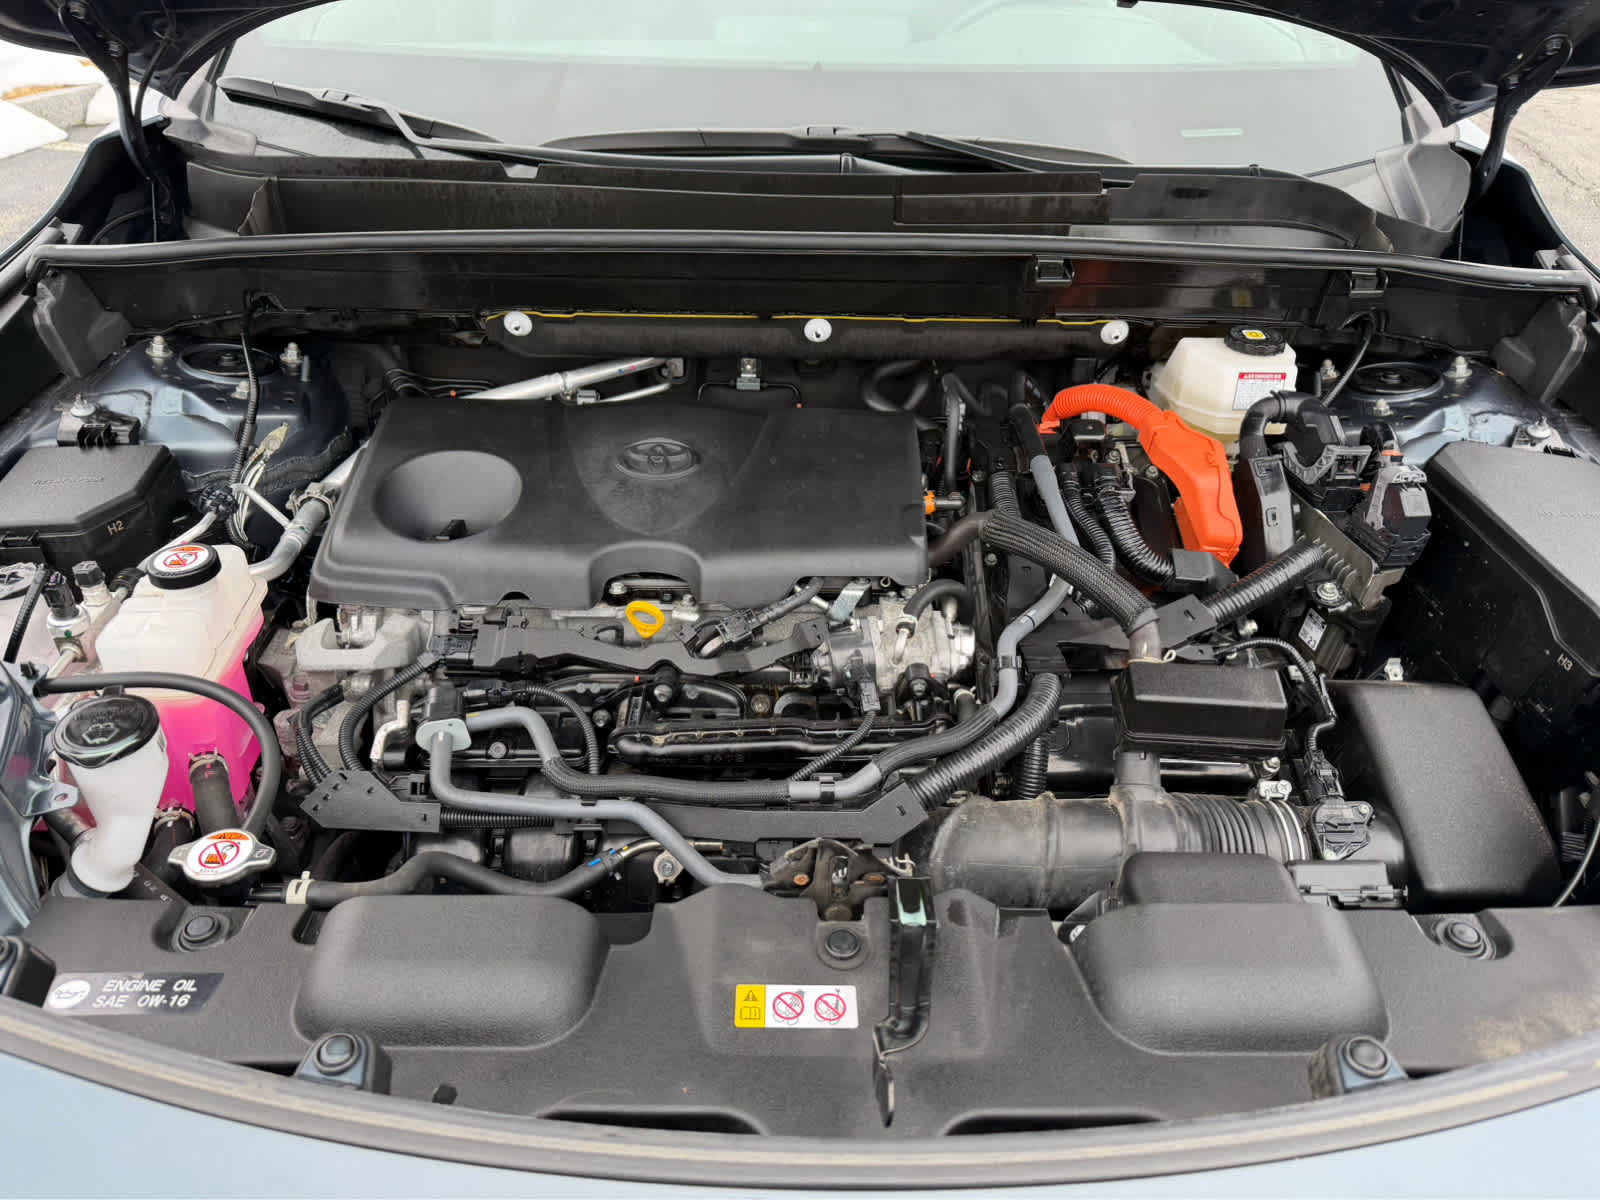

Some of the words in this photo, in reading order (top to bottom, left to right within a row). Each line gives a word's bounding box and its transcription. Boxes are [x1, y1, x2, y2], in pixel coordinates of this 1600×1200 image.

[107, 520, 125, 536] H2
[1557, 653, 1573, 671] H3
[103, 979, 165, 992] ENGINE
[173, 979, 197, 992] OIL
[92, 994, 129, 1008] SAE
